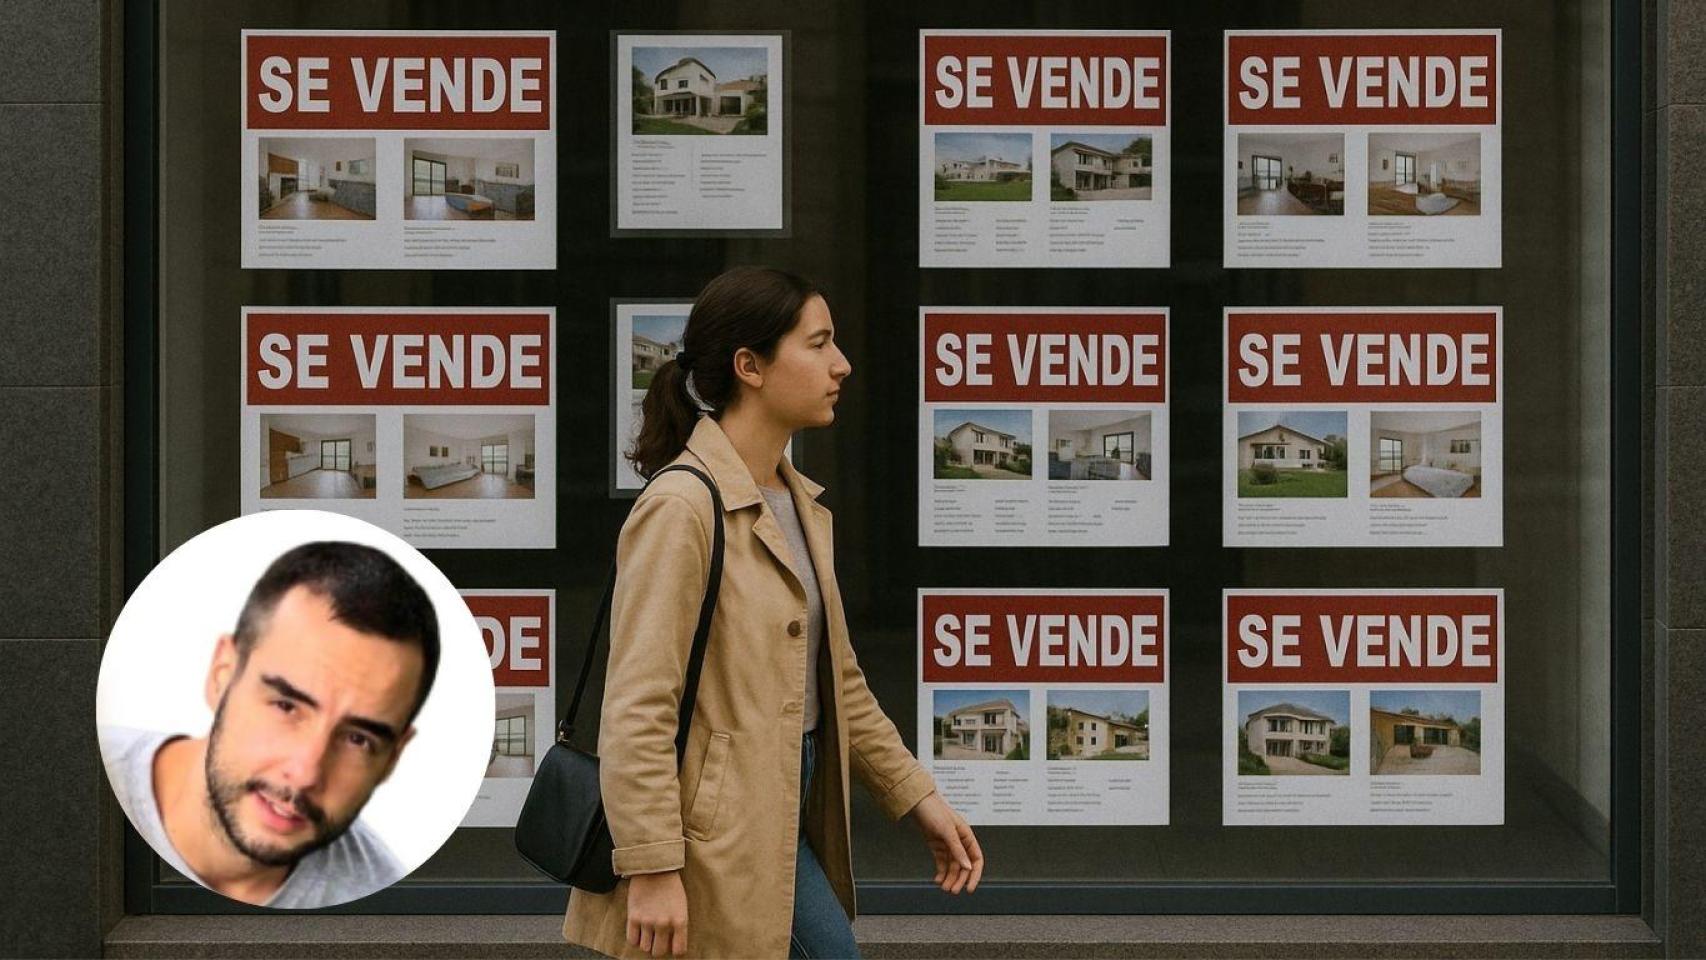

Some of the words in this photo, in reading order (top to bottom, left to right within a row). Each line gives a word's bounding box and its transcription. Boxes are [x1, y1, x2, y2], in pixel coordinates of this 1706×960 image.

[258, 56, 330, 113] SE
[351, 57, 541, 113] VENDE
[935, 56, 993, 109] SE
[1007, 57, 1160, 109] VENDE
[1239, 56, 1300, 109] SE
[1319, 56, 1488, 108] VENDE
[258, 333, 329, 389] SE
[350, 334, 541, 389] VENDE
[936, 333, 992, 386] SE
[1007, 334, 1159, 386] VENDE
[1238, 333, 1301, 387] SE
[1320, 334, 1490, 386] VENDE
[934, 614, 991, 667] SE
[1006, 615, 1157, 667] VENDE
[1237, 615, 1301, 668] SE
[1320, 615, 1491, 667] VENDE
